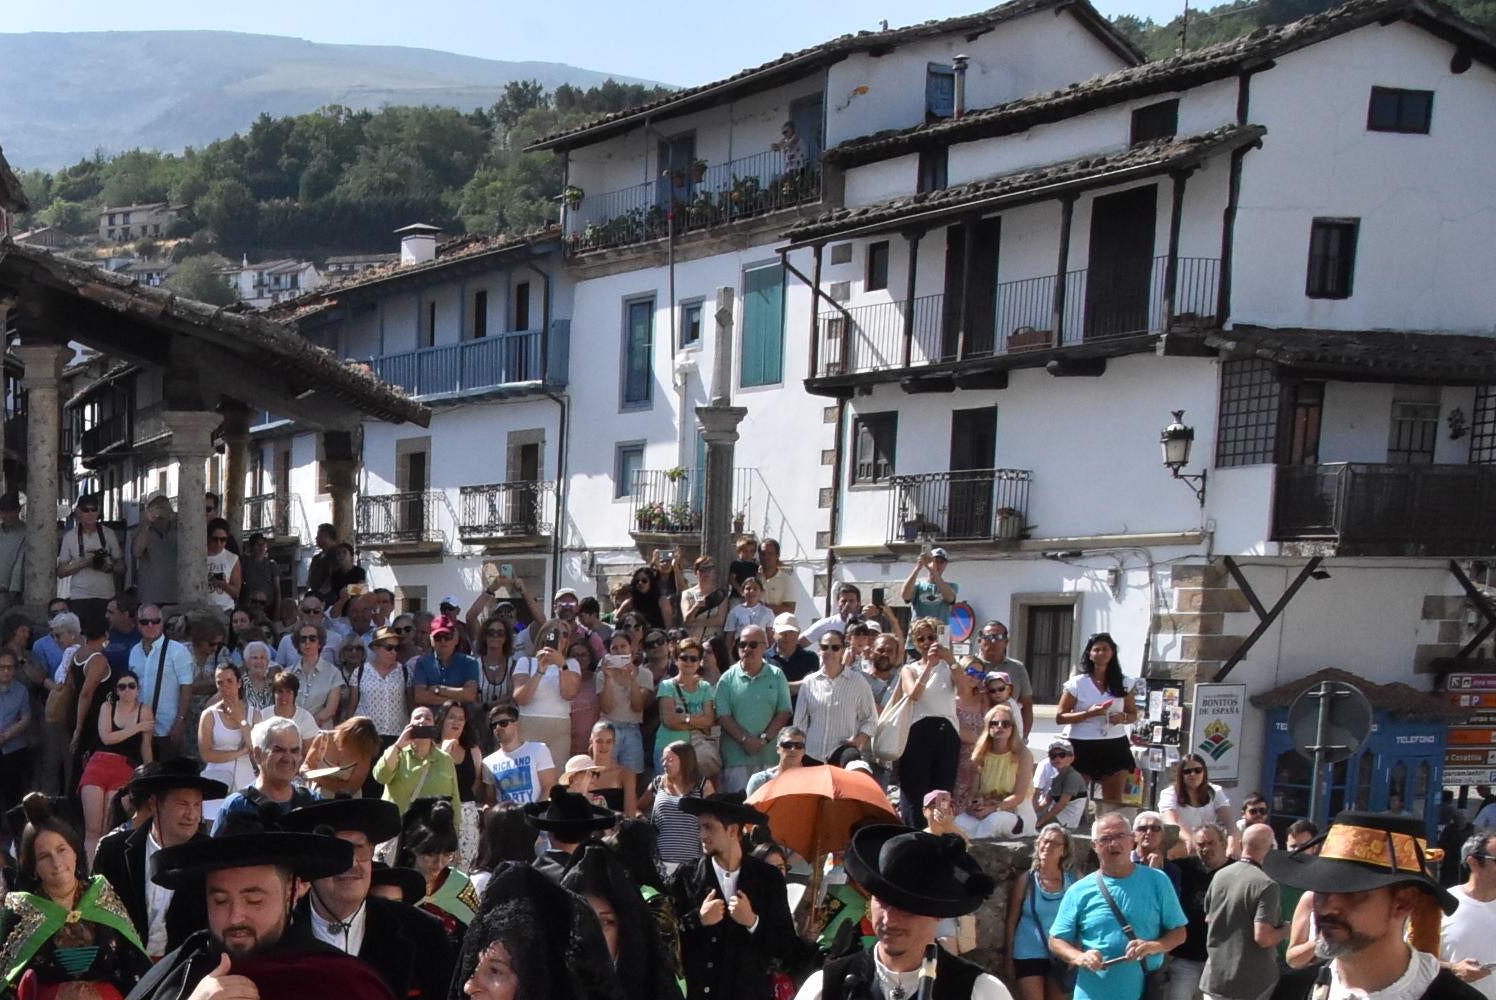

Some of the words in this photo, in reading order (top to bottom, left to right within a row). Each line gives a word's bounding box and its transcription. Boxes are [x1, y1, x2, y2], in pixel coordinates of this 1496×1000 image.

[1202, 698, 1238, 707] BONITOS
[1198, 707, 1209, 716] DE
[493, 760, 511, 772] RICK
[514, 755, 531, 767] AND
